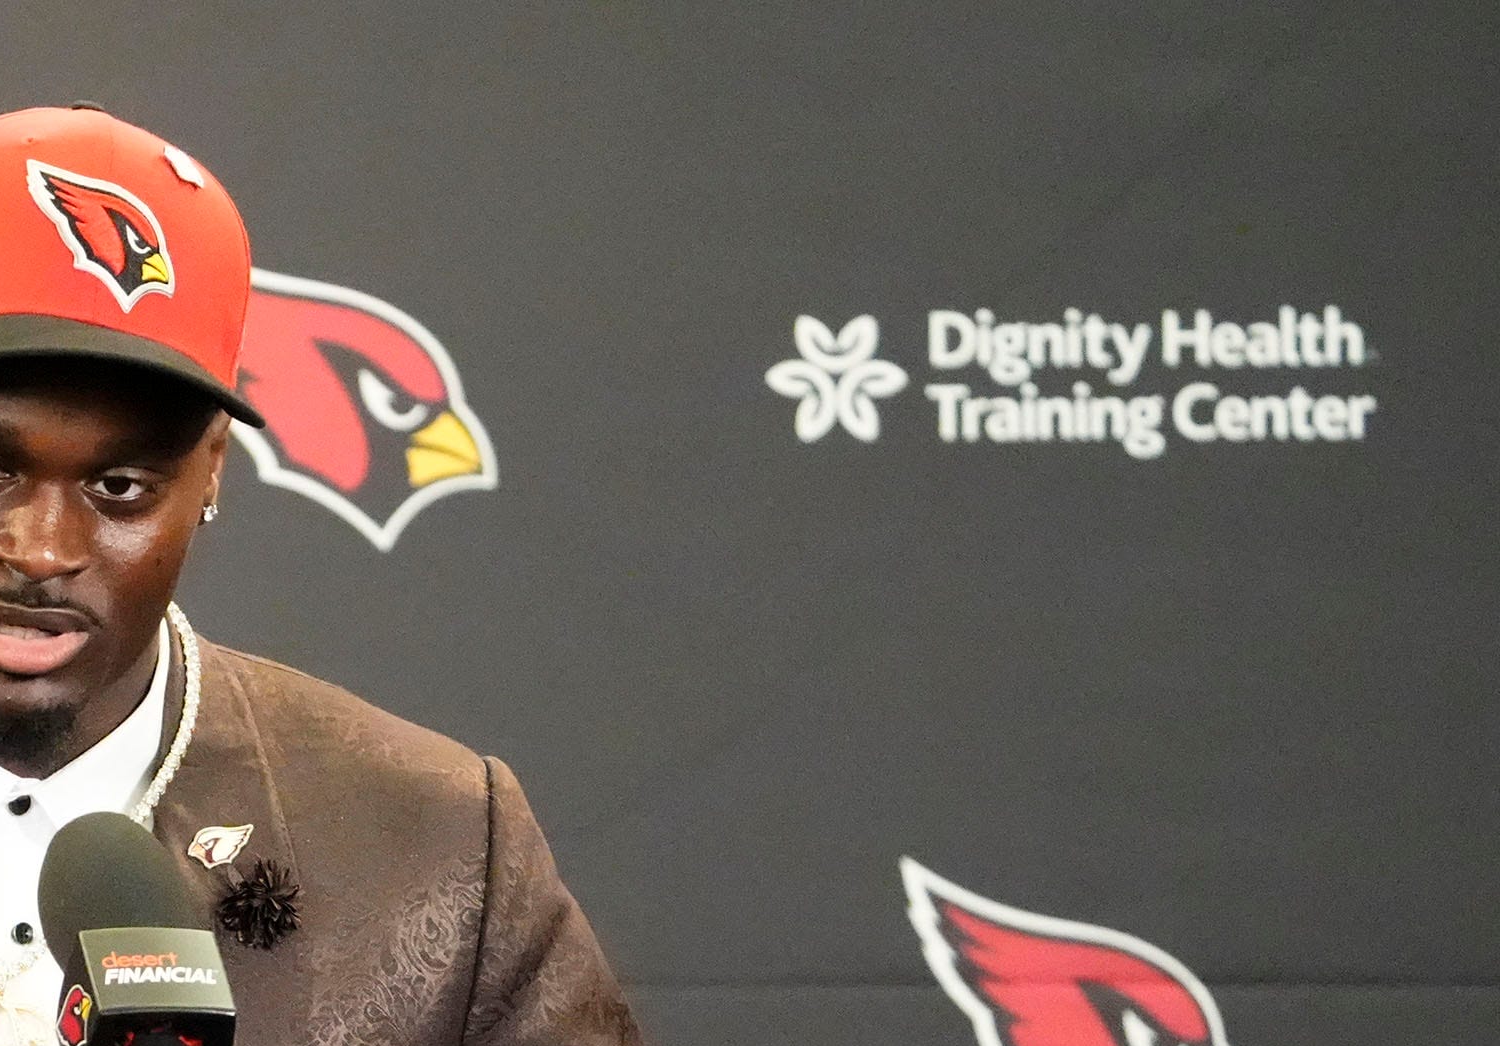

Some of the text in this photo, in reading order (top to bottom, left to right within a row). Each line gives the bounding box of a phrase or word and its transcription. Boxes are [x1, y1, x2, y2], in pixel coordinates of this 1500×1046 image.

[928, 304, 1364, 386] Dignity Health
[925, 381, 1376, 459] Training Center
[102, 951, 178, 967] desert
[104, 966, 217, 985] FINANCIAL
